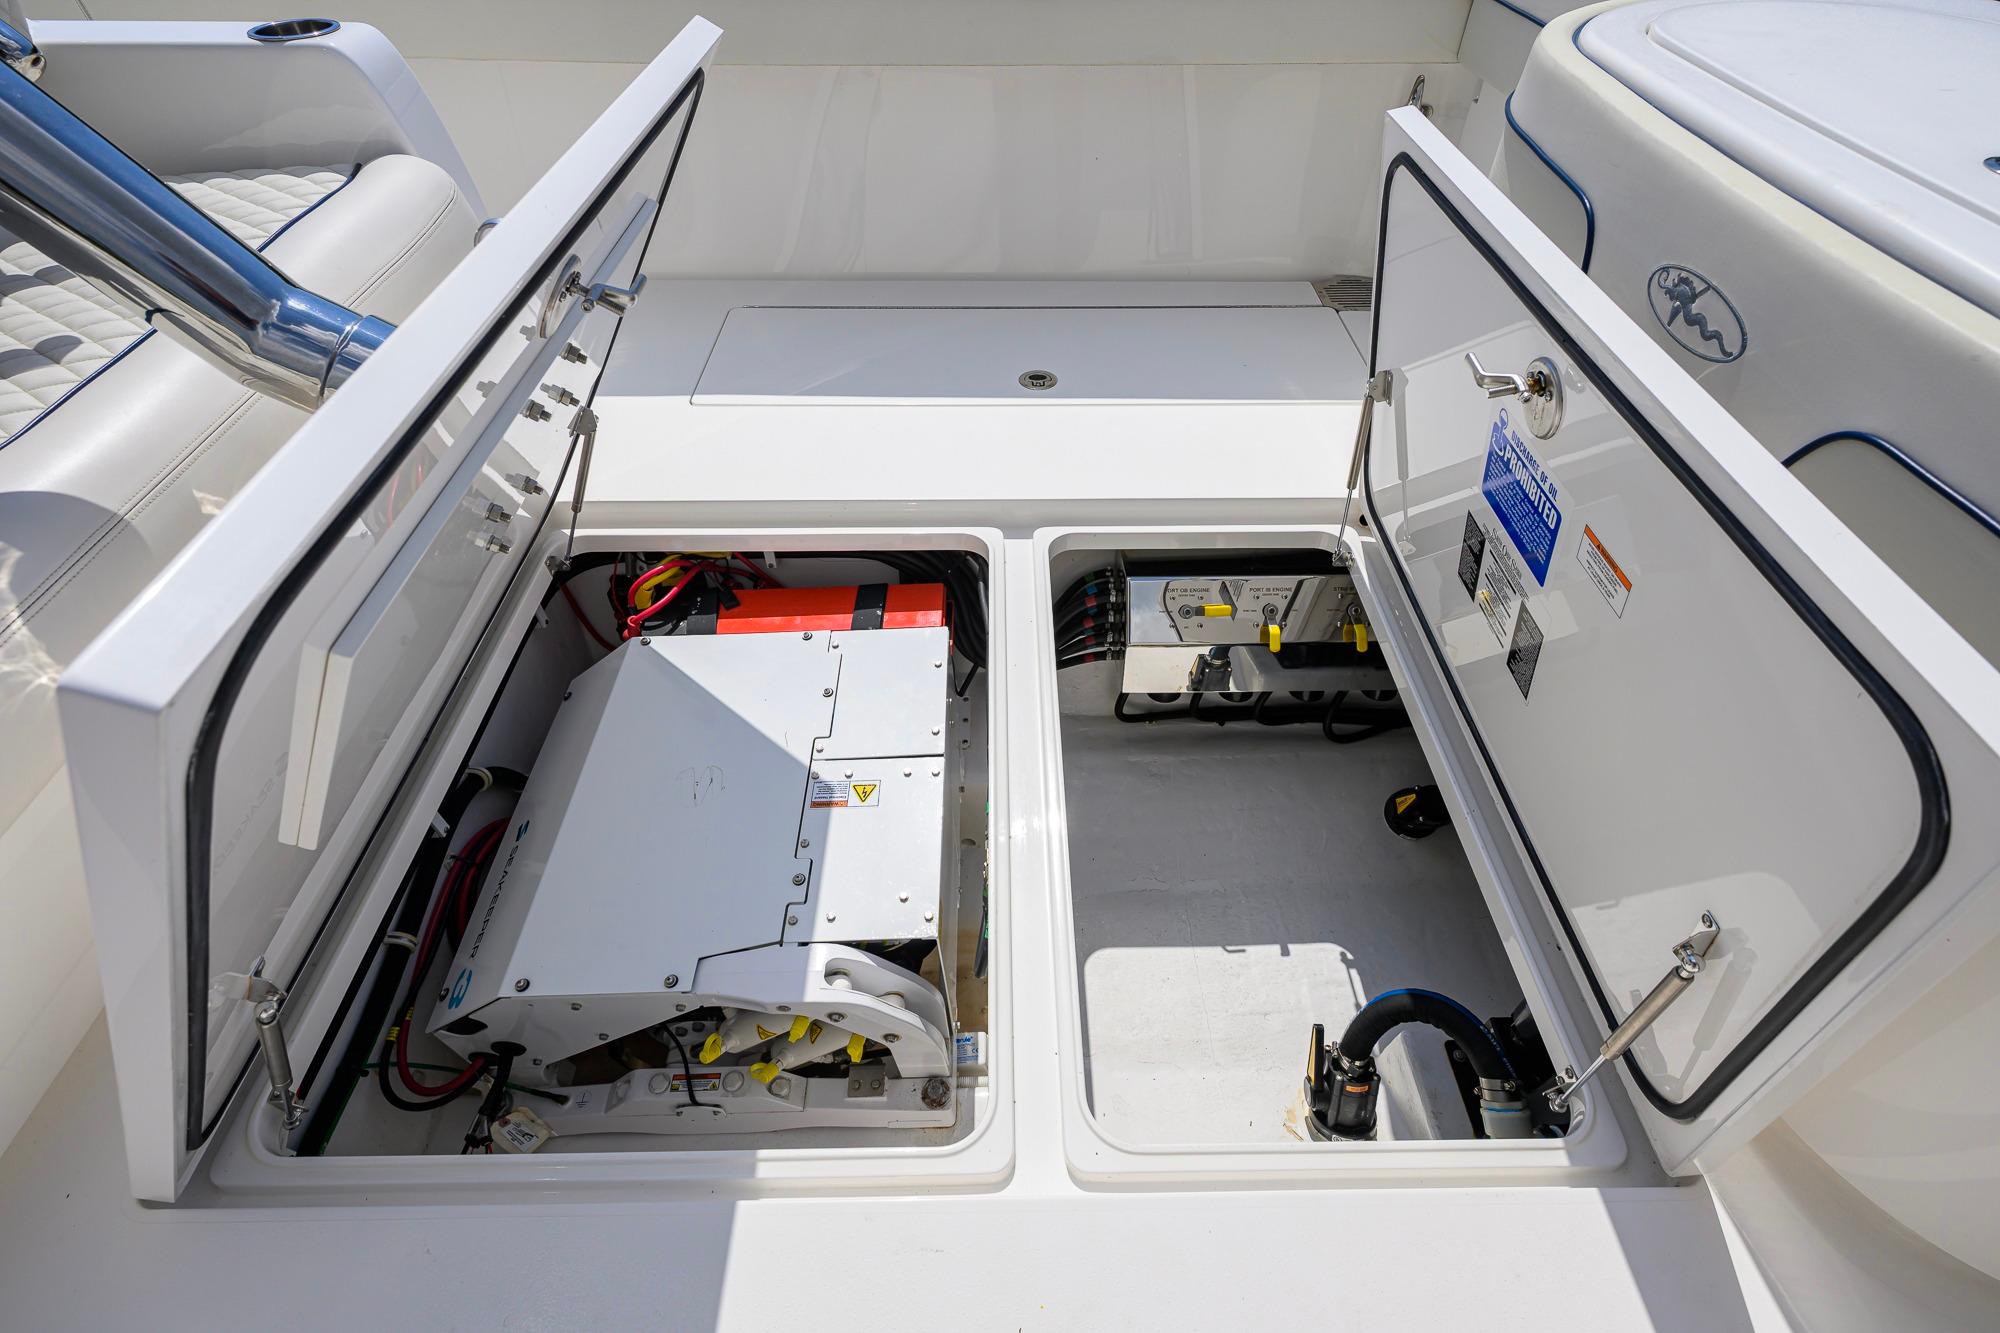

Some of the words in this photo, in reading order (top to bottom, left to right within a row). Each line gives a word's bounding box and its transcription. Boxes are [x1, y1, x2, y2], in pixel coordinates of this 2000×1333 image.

[1504, 444, 1558, 530] PROHIBITED
[1511, 430, 1540, 474] DISCHARGE
[1540, 472, 1548, 486] OF
[1548, 482, 1558, 502] OIL
[470, 845, 519, 959] SEAKEEPER
